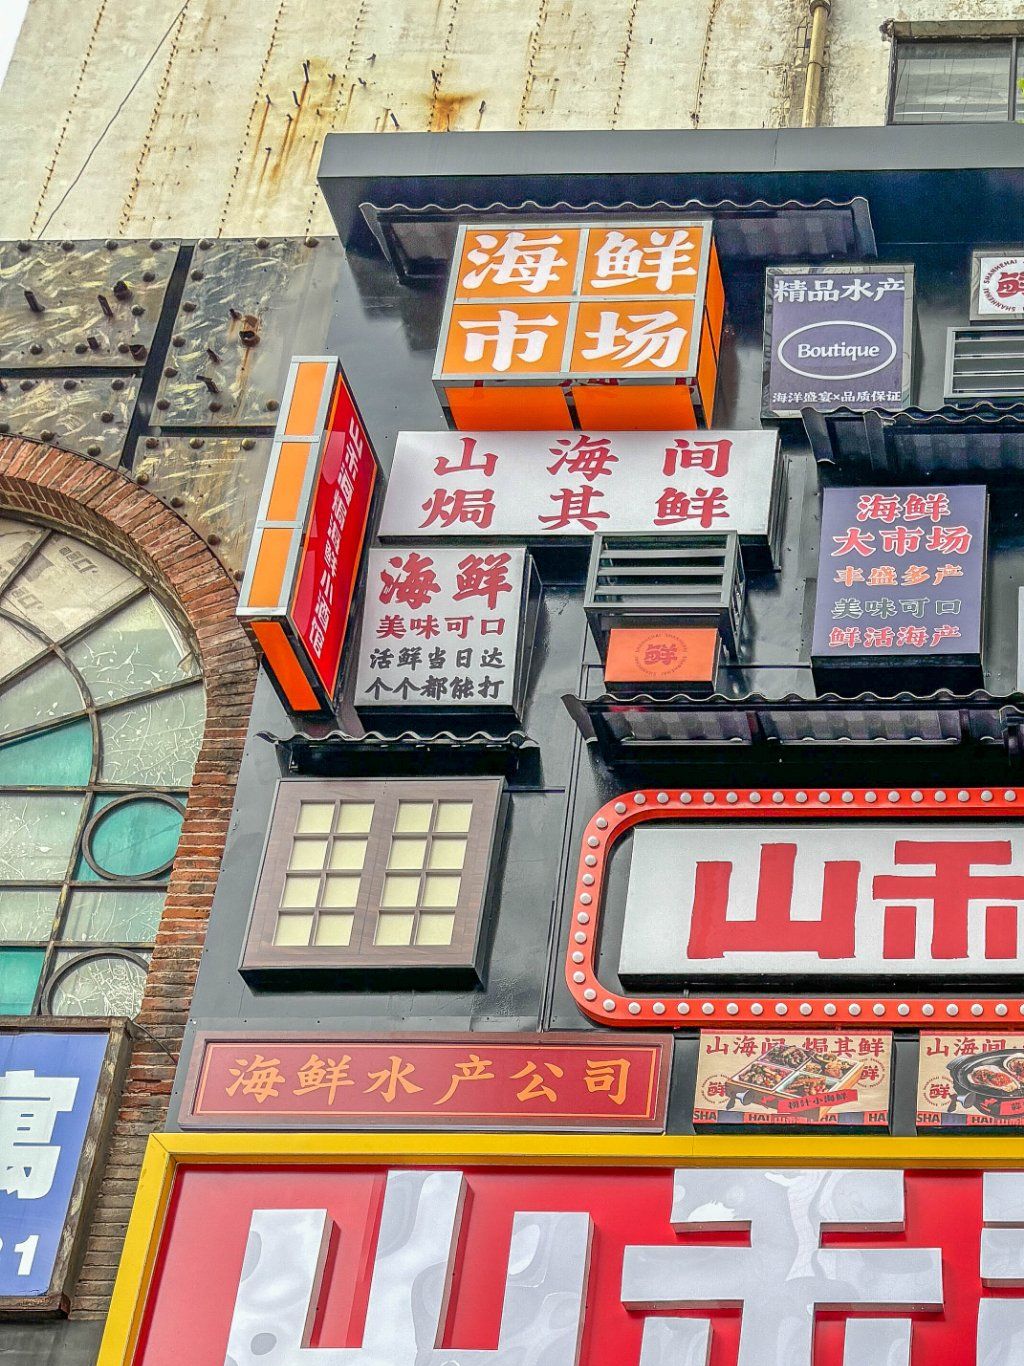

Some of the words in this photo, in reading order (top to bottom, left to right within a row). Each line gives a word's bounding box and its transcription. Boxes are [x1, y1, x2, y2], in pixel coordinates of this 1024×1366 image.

[462, 230, 697, 293] 海鲜
[774, 277, 905, 303] 精品水产
[459, 310, 688, 371] 市场
[798, 343, 880, 363] Boutique
[436, 434, 733, 481] 山海间
[419, 485, 730, 532] 焗其鲜
[856, 493, 951, 523] 海鲜
[830, 526, 972, 557] 大市场
[378, 552, 512, 610] 海鲜
[833, 564, 964, 587] 丰盛多产
[831, 597, 962, 619] 美味可口
[375, 616, 506, 640] 美味可口
[828, 625, 961, 648] 鲜活海产
[370, 648, 506, 671] 活鲜当日达
[364, 675, 505, 701] 个个都能打
[224, 1054, 632, 1105] 海鲜水产公司
